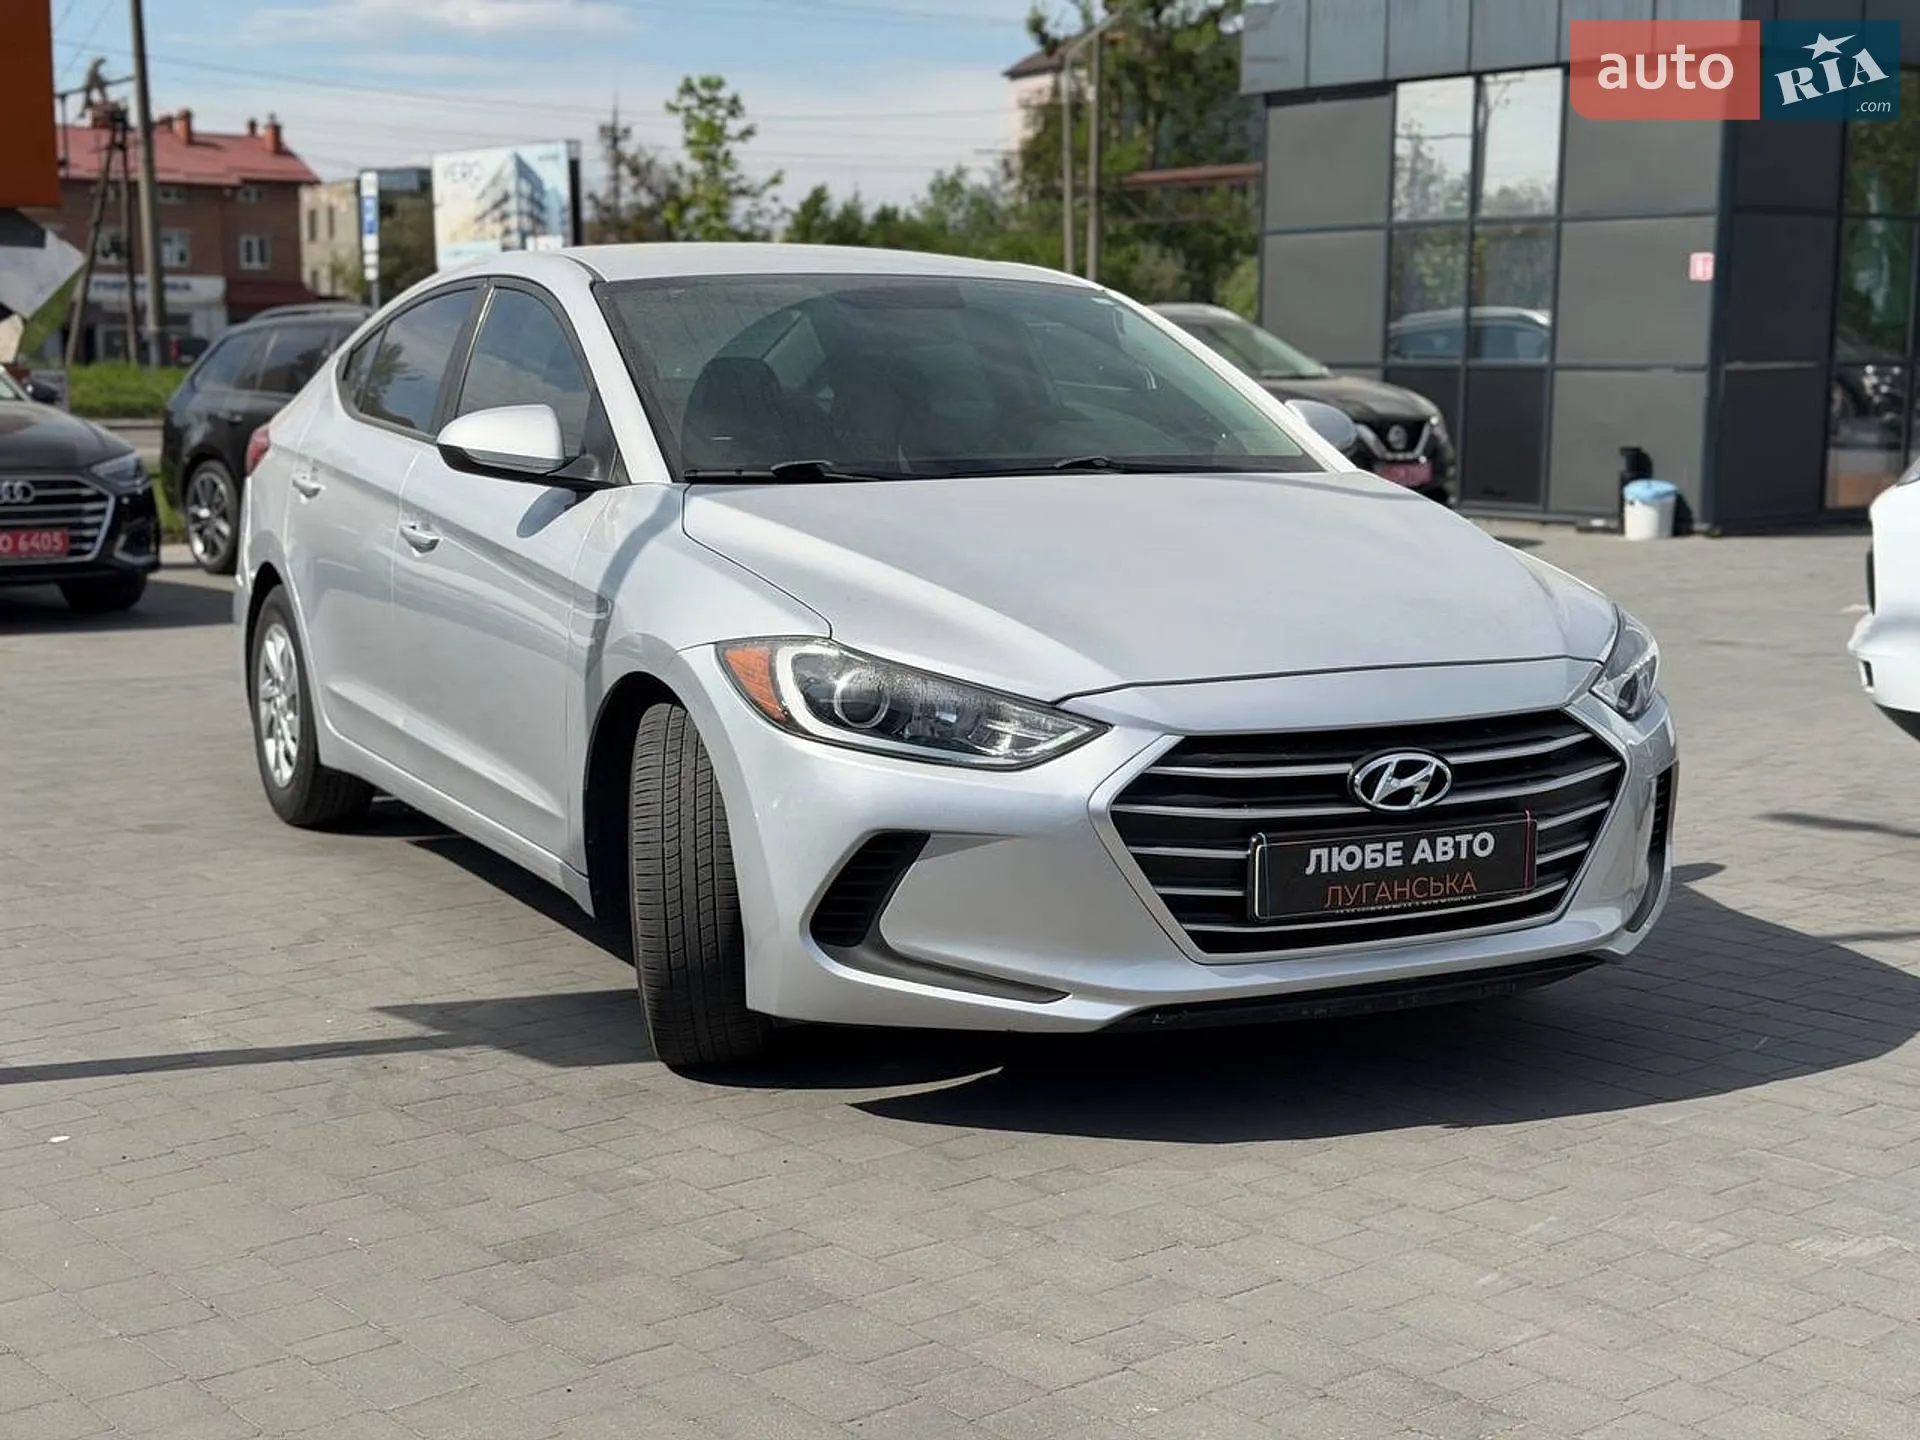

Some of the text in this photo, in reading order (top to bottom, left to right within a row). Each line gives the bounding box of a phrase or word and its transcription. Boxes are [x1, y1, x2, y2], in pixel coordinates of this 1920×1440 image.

[1305, 832, 1496, 876] ЛЮБЕ АВТО
[1324, 872, 1478, 908] ЛУГАНСЬКА
